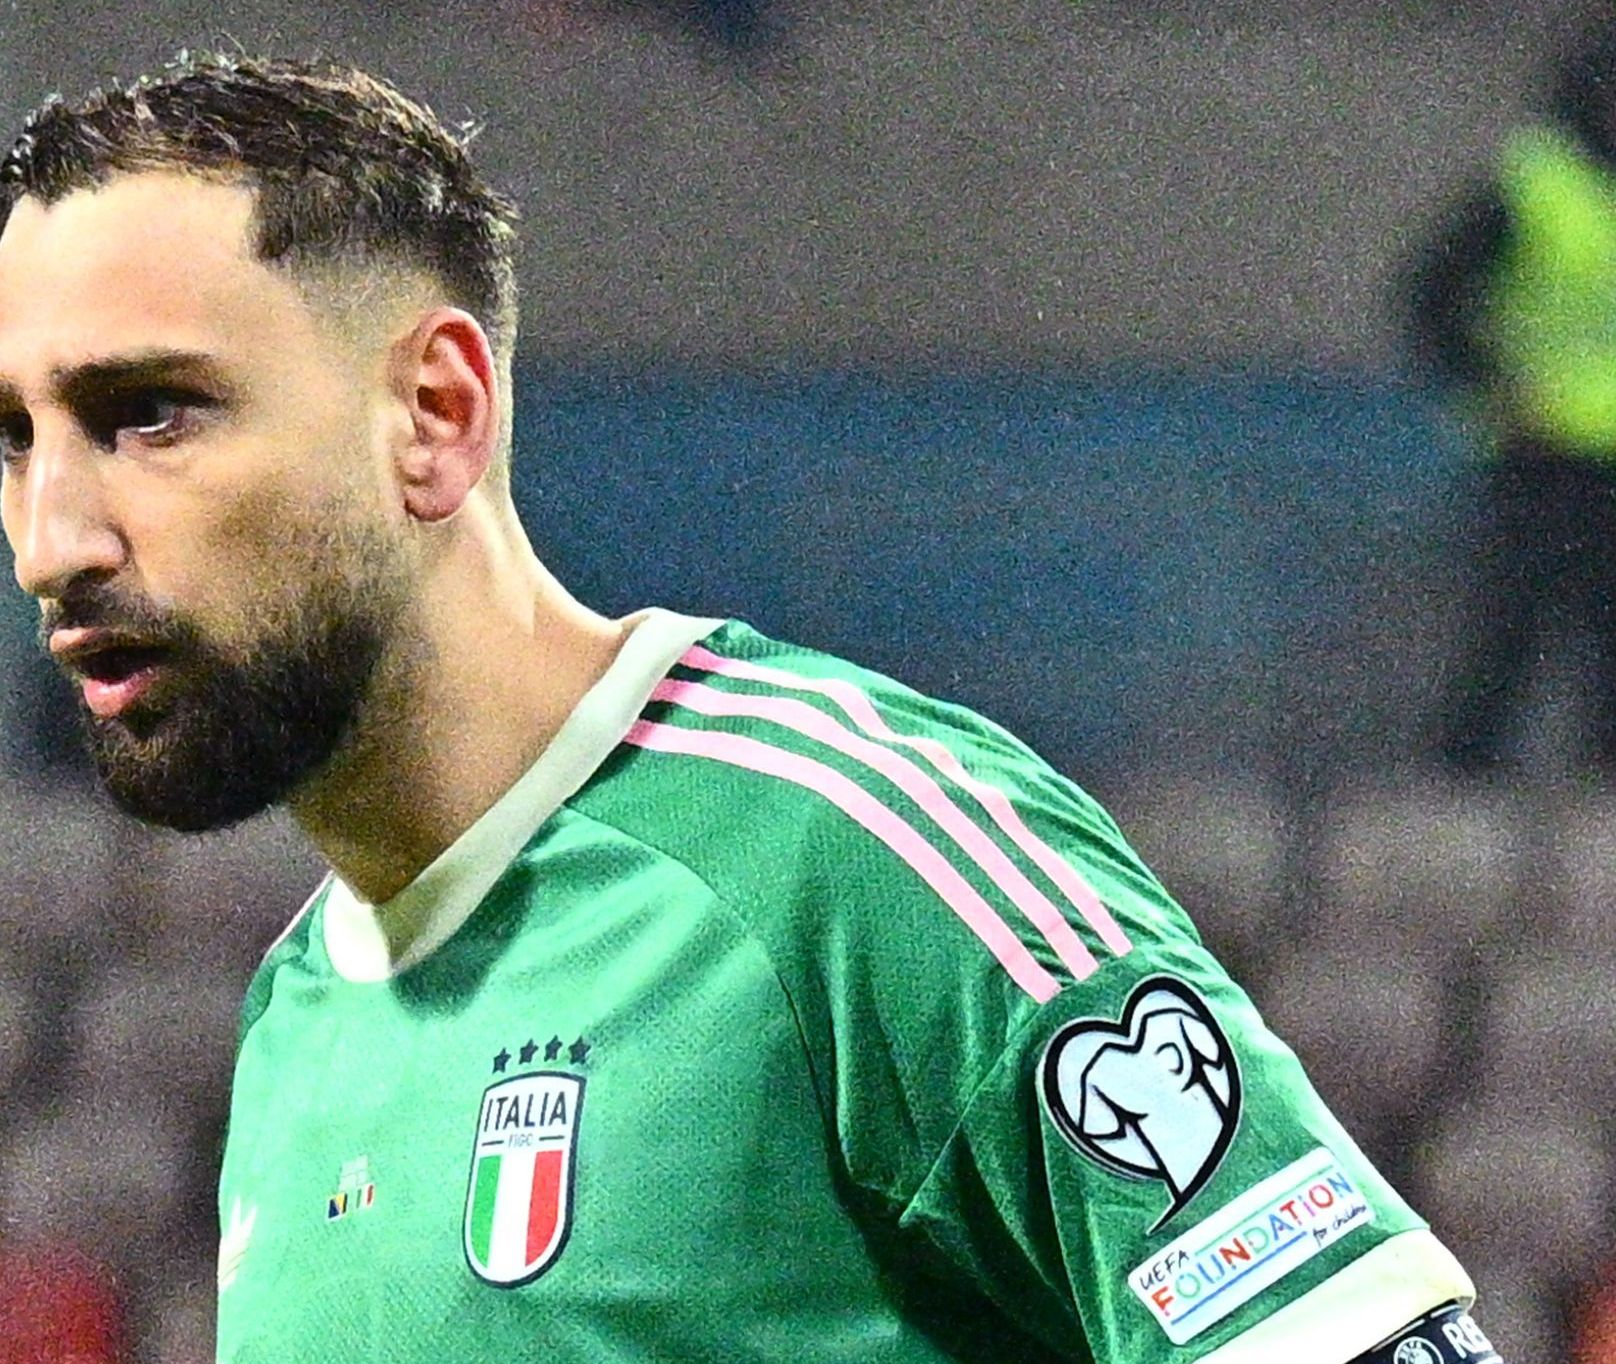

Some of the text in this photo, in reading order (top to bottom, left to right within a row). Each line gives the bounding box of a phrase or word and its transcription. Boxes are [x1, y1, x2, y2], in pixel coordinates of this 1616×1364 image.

[483, 1091, 567, 1132] ITALIA
[1151, 1172, 1354, 1317] FOUNDATION
[1139, 1249, 1190, 1290] UEFA
